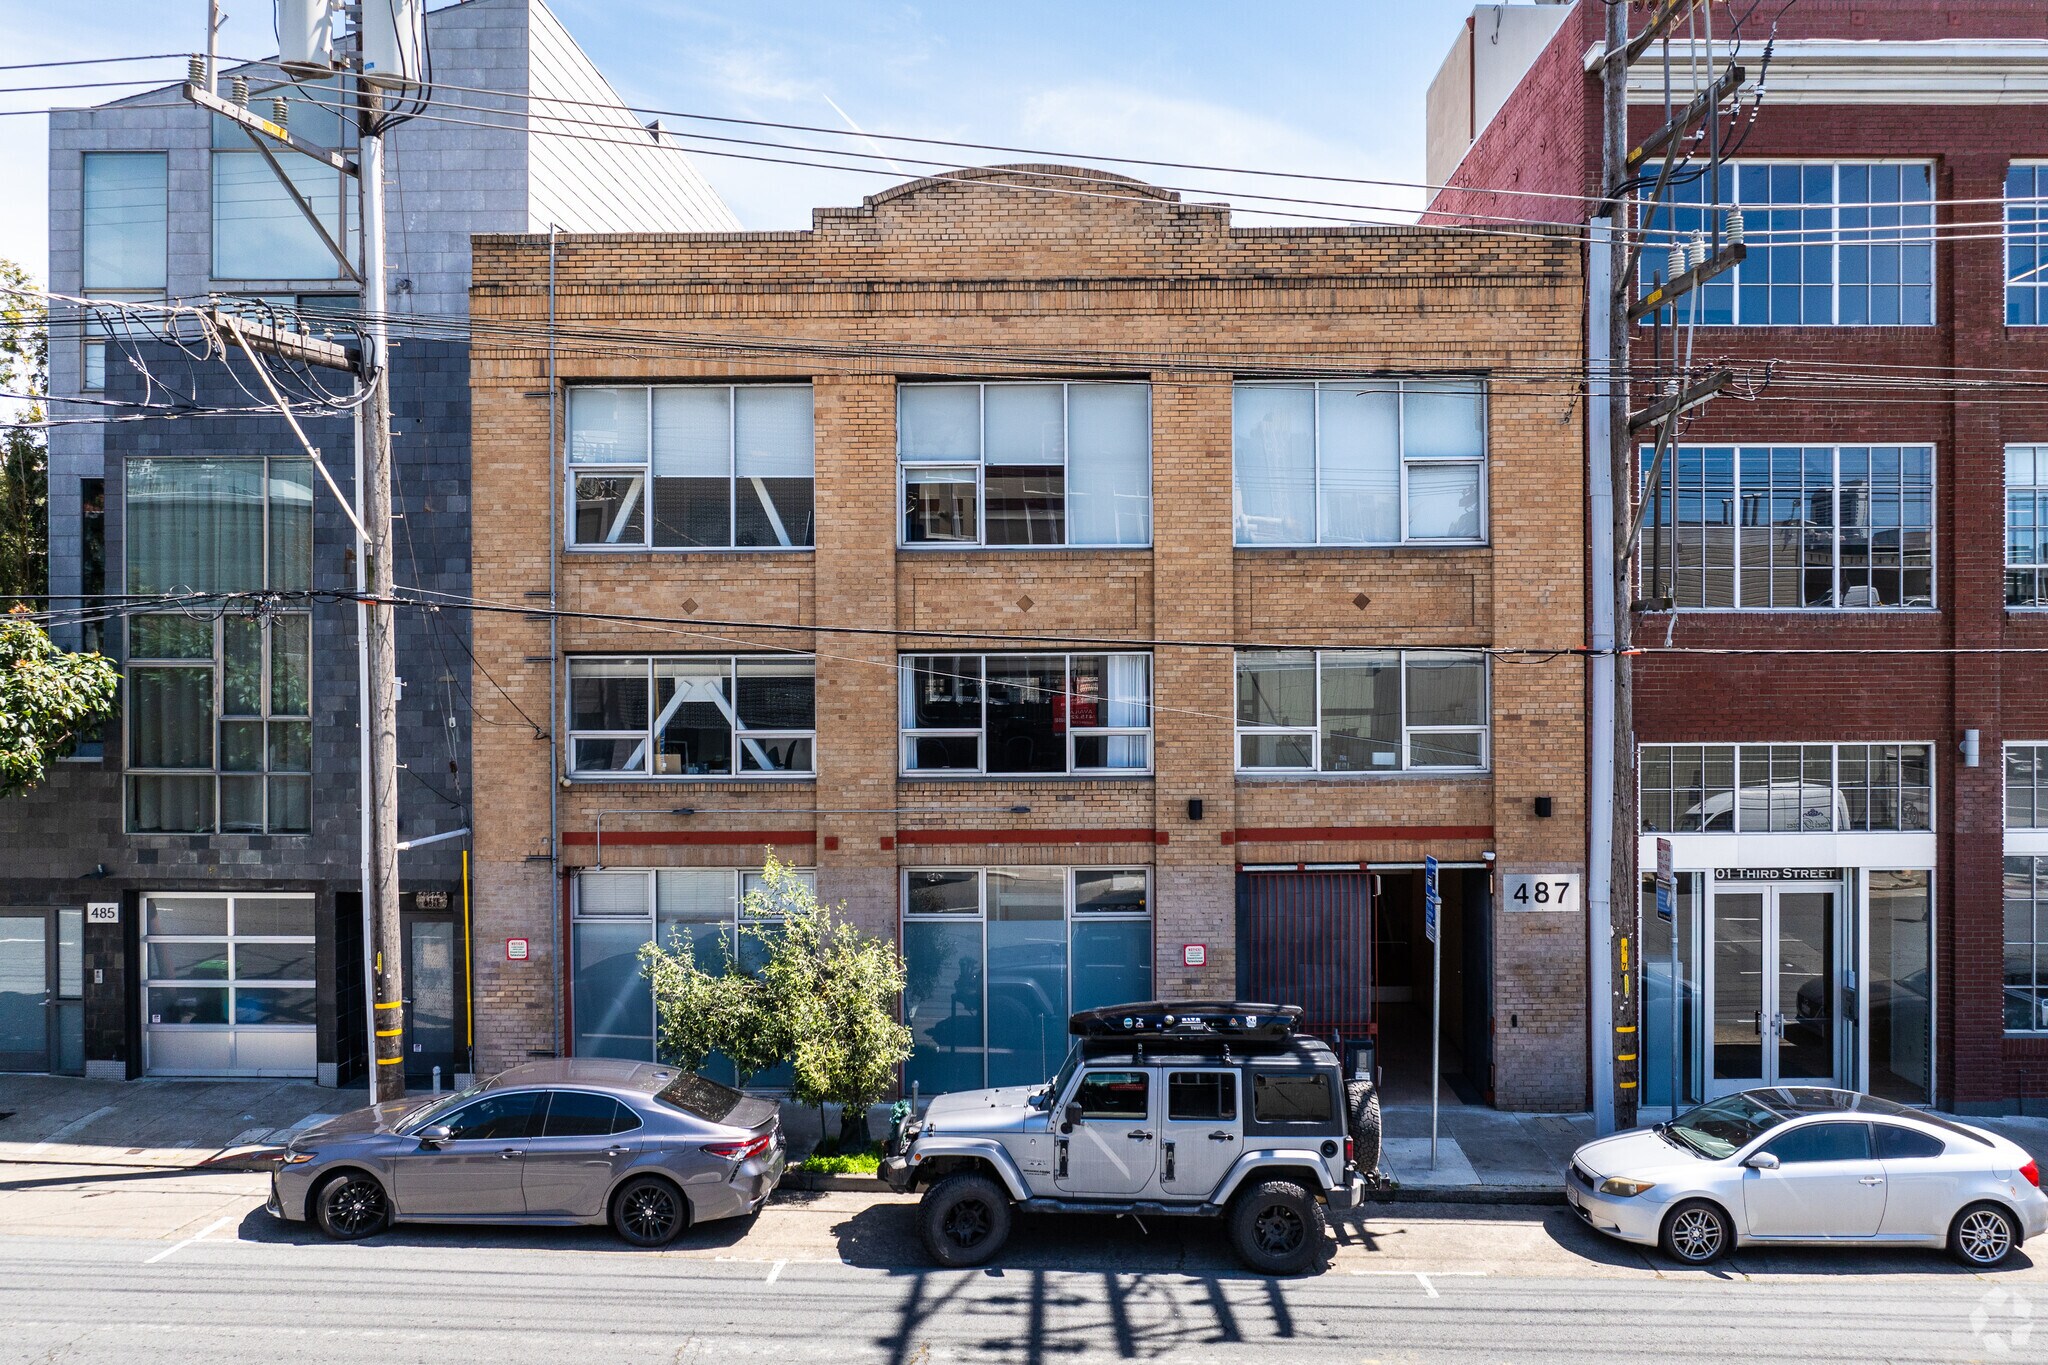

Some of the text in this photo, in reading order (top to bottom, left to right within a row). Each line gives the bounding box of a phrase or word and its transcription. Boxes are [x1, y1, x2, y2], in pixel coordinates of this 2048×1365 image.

[1737, 868, 1779, 879] THIRD
[1783, 868, 1835, 879] STREET
[1513, 881, 1570, 904] 487
[91, 907, 115, 919] 485
